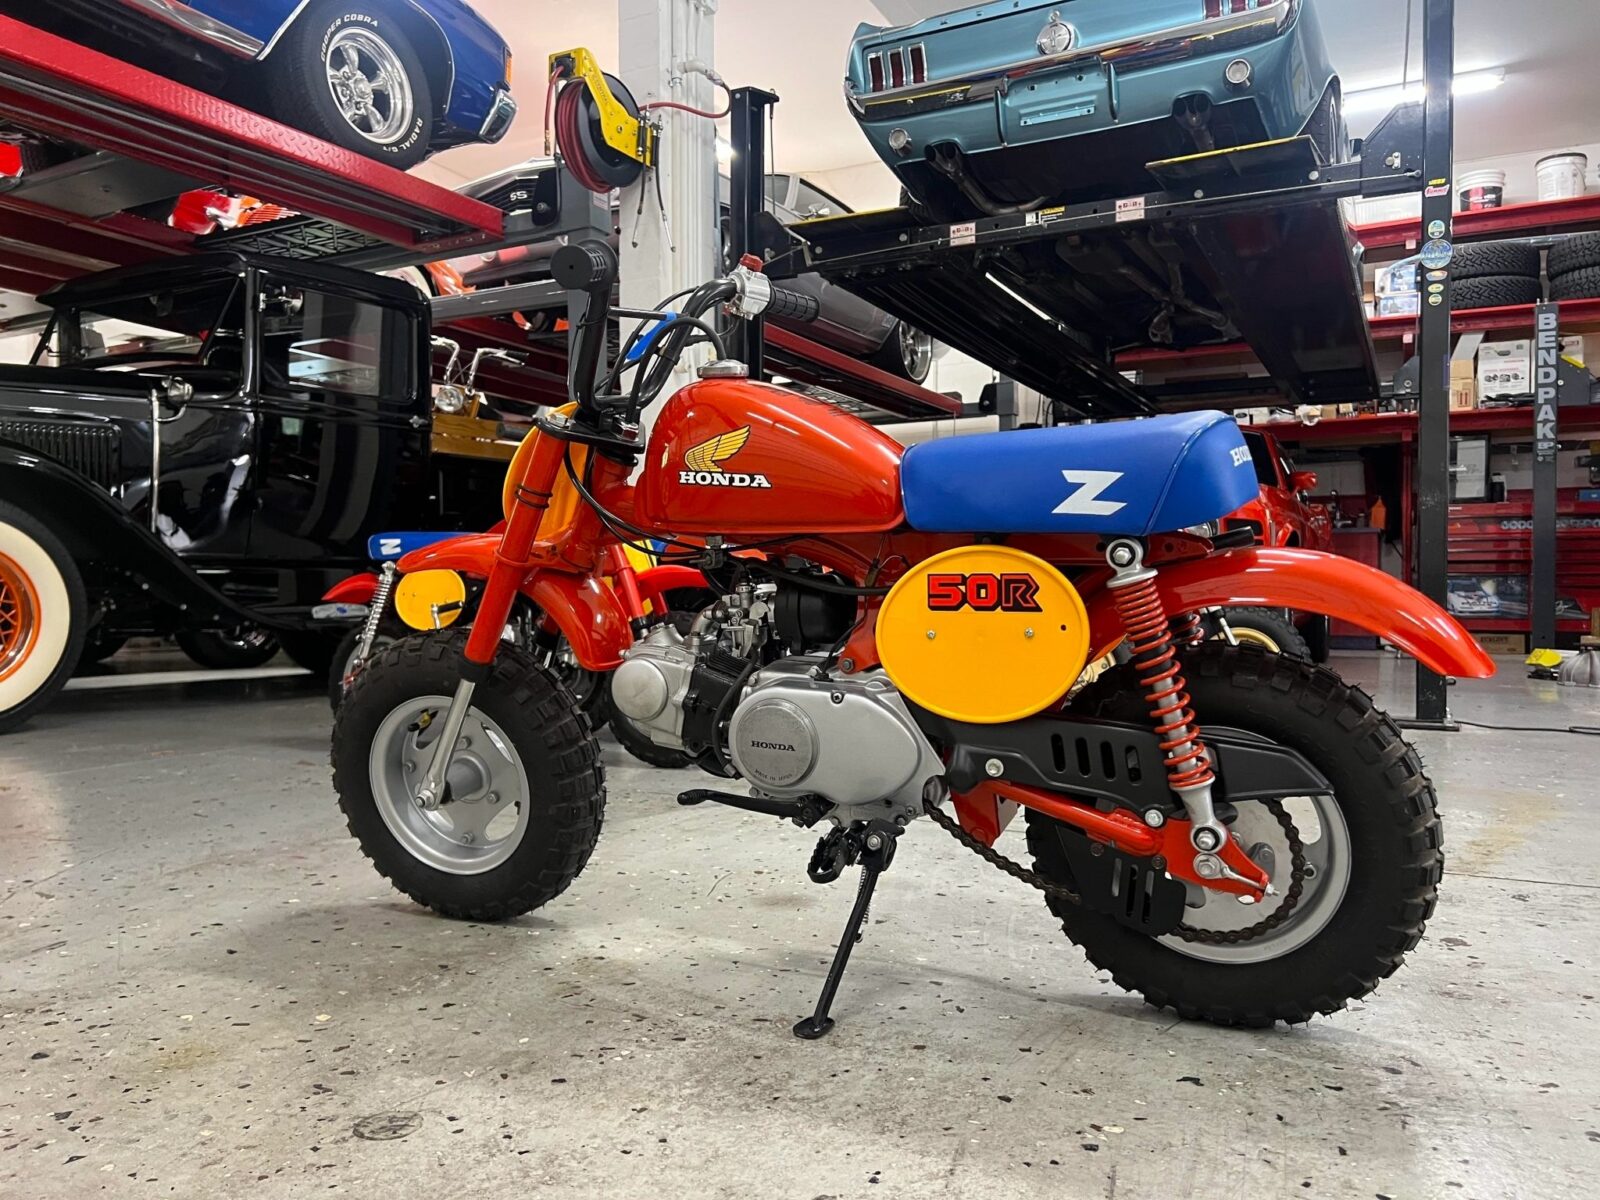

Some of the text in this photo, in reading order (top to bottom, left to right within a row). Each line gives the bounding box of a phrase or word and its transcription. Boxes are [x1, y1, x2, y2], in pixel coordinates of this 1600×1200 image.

[320, 13, 379, 62] COOPER COBRA
[398, 117, 423, 151] RADIAL
[509, 190, 528, 201] SS
[1536, 312, 1557, 439] BENDPAK
[679, 471, 772, 488] HONDA
[1051, 469, 1128, 516] Z
[927, 573, 1043, 612] 50R
[751, 740, 796, 752] HONDA
